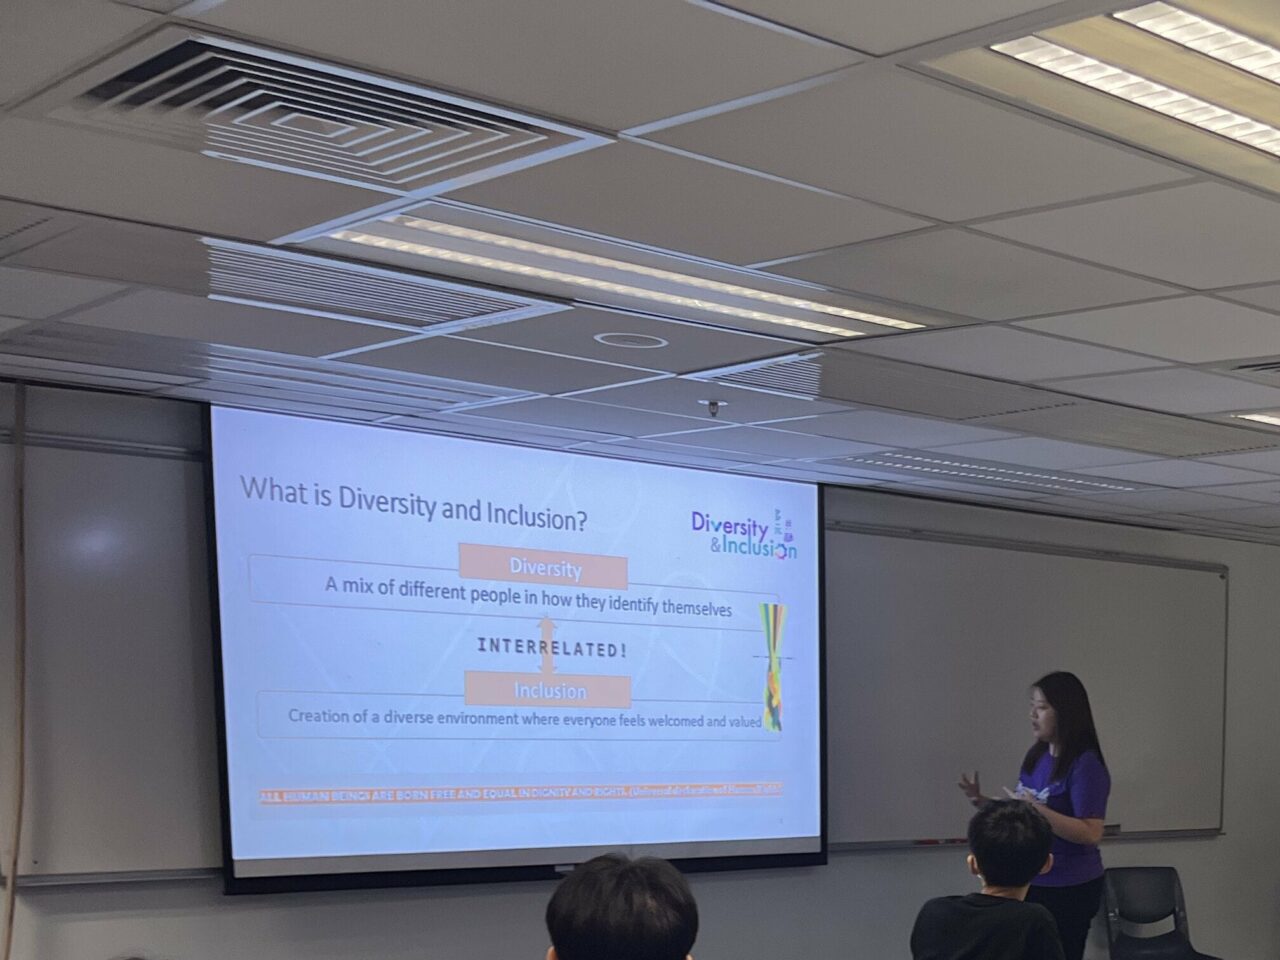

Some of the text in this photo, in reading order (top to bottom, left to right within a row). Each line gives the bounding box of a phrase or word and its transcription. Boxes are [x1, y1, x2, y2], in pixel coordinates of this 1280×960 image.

[240, 474, 588, 532] What is Diversity and Inclusion?
[691, 511, 769, 543] Diversity
[710, 534, 798, 560] &Inclusion
[510, 556, 583, 583] Diversity
[325, 576, 733, 618] A mix of different people in how they identify themselves
[477, 637, 627, 658] INTERRELATED!
[514, 681, 588, 699] Inclusion
[288, 708, 762, 729] Creation of a diverse environment where everyone feels welcomed and valued
